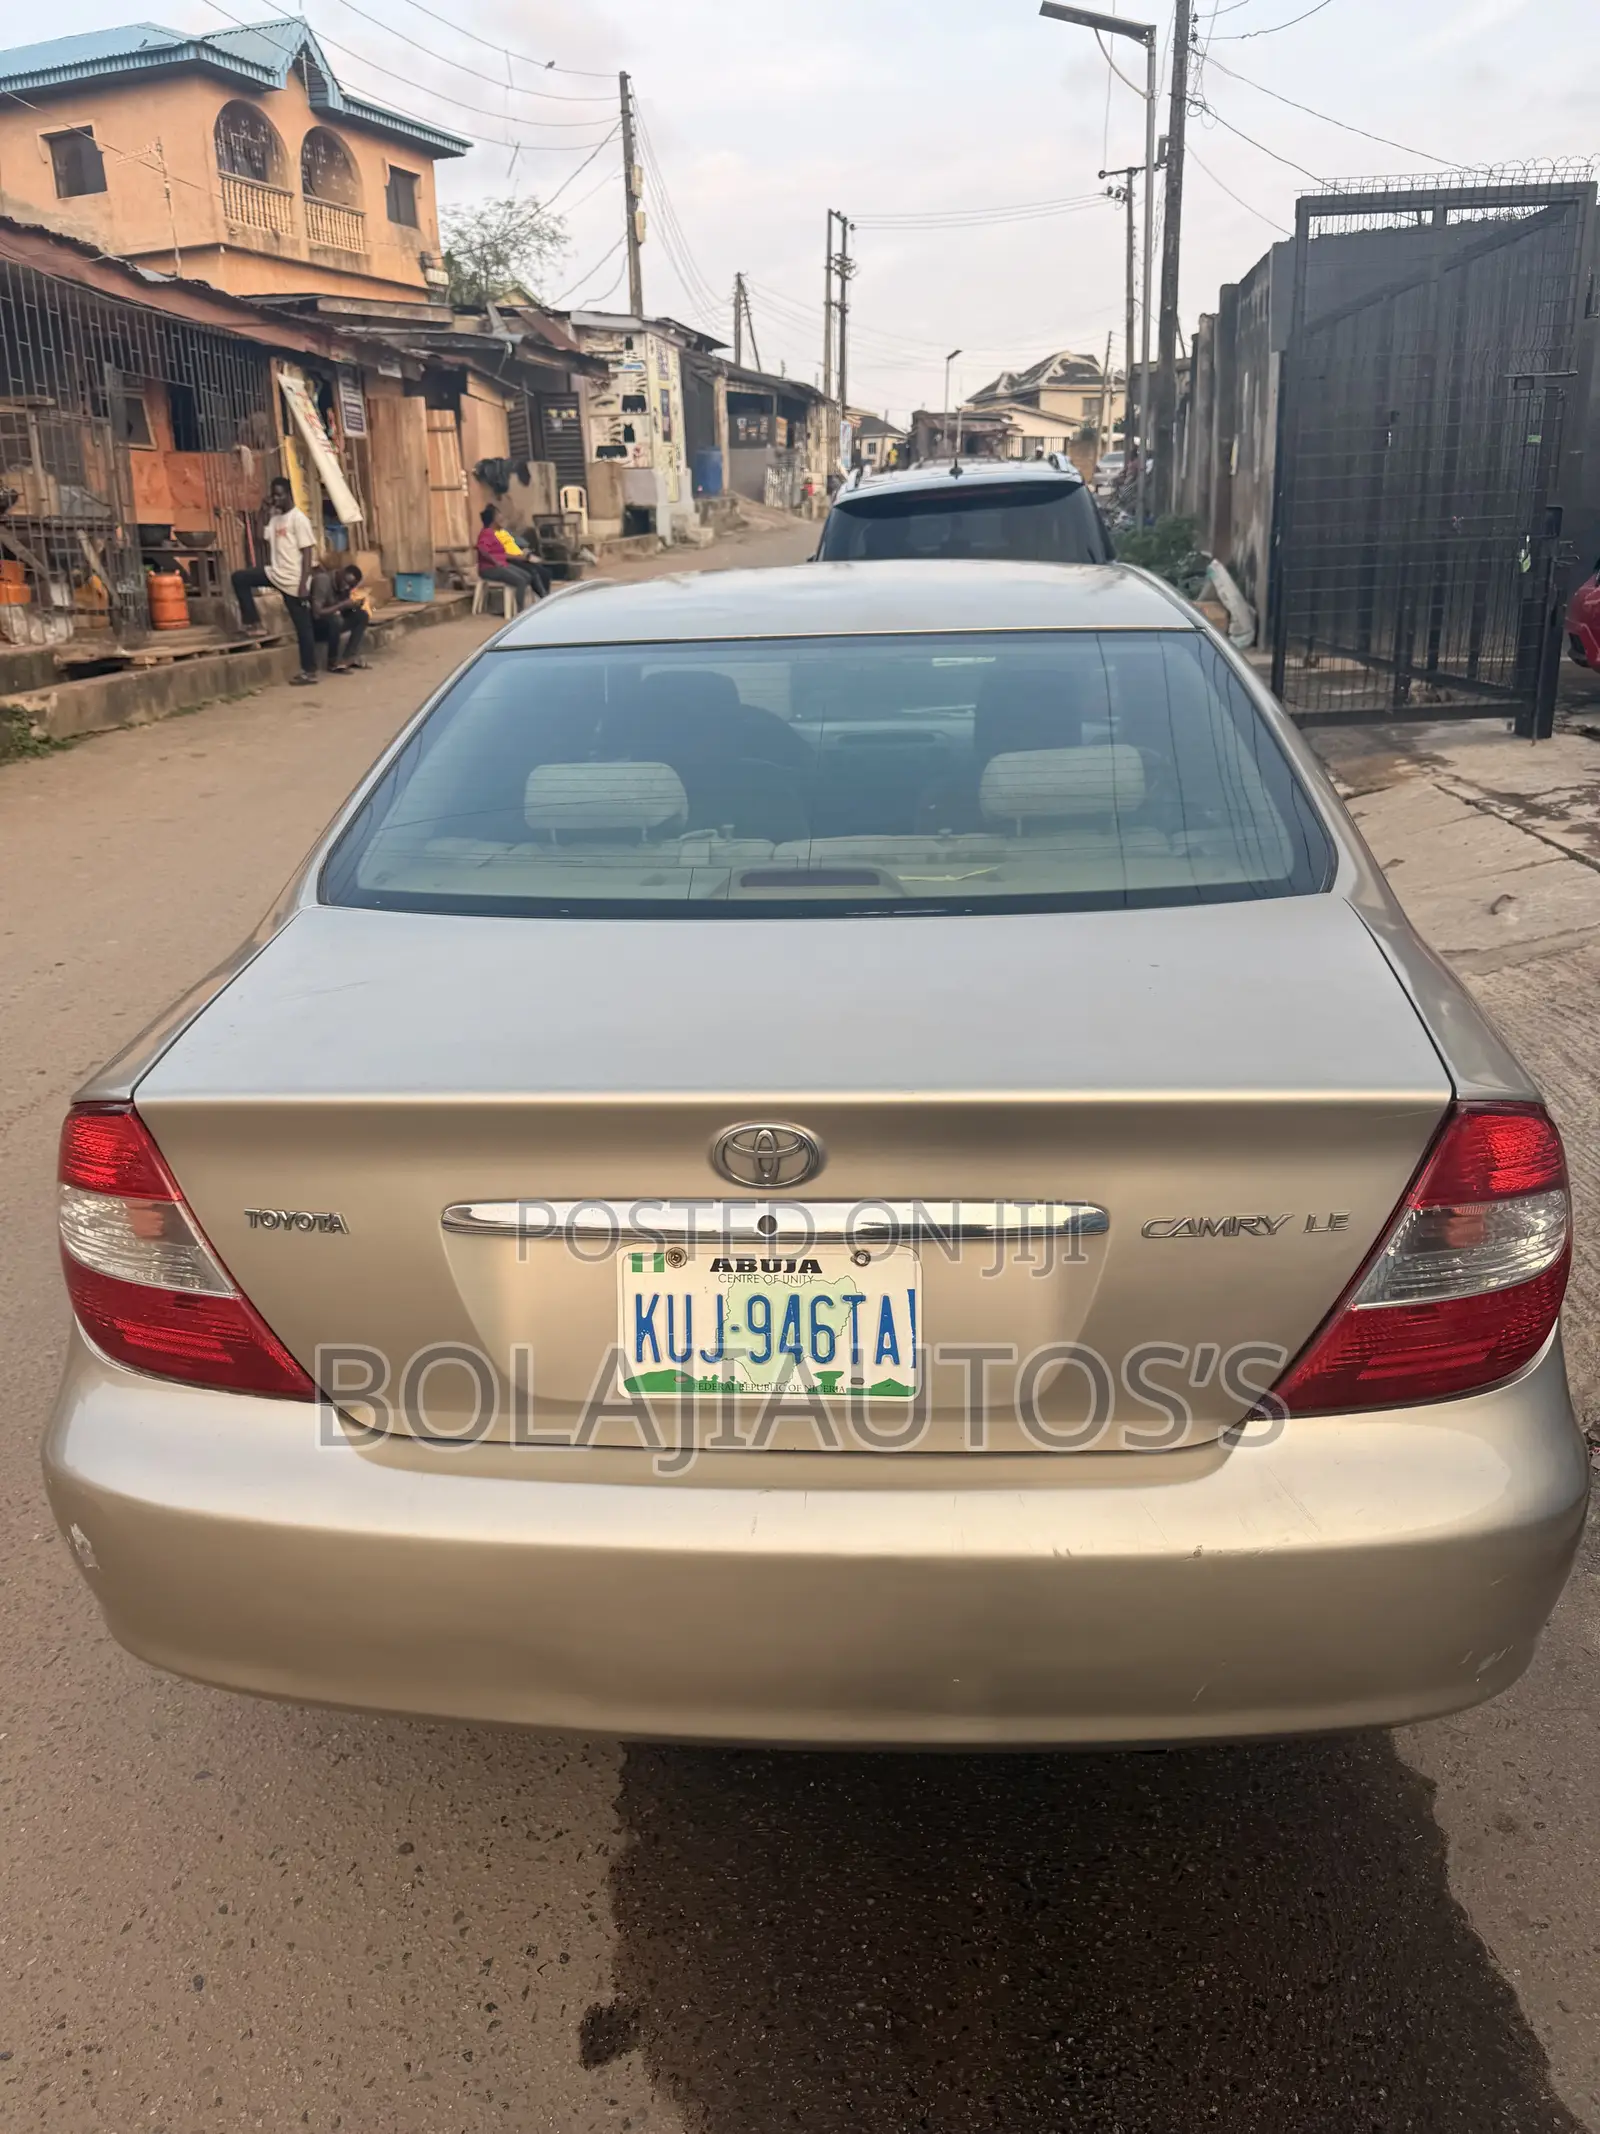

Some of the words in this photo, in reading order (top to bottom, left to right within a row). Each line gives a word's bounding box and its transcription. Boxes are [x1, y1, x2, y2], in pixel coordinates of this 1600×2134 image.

[244, 1208, 350, 1234] TOYOTA
[1141, 1212, 1295, 1238] CAMRY
[1303, 1210, 1352, 1233] LE
[709, 1258, 822, 1273] ABUJA
[718, 1273, 760, 1284] CENTRE
[763, 1273, 779, 1284] OF
[783, 1274, 814, 1284] UNITY
[788, 1384, 803, 1393] OF
